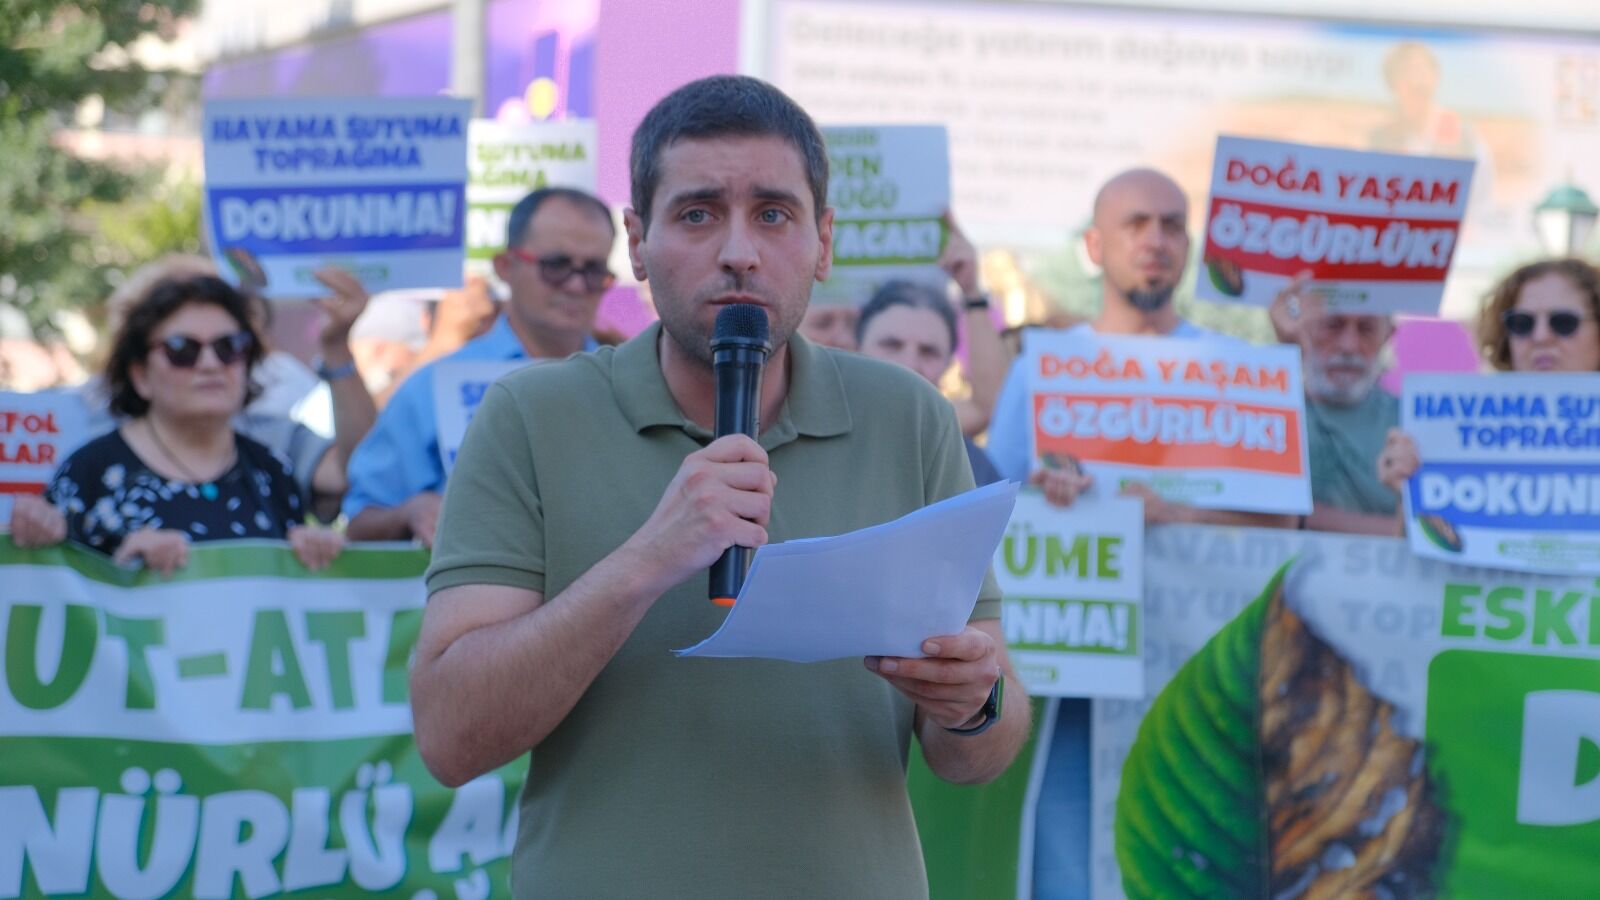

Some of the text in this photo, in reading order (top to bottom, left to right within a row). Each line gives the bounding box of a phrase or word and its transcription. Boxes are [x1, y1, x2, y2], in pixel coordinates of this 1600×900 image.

[212, 116, 461, 139] HAVAMA SUYUMA
[1226, 156, 1459, 213] DOĞA YAŞAM
[220, 191, 457, 242] DOKUNMA!
[1208, 203, 1458, 268] ÖZGÜRLÜK!
[1039, 350, 1289, 396] DOĞA YAŞAM
[1038, 396, 1287, 454] ÖZGÜRLÜK!
[1413, 394, 1548, 418] HAVAMA
[1420, 472, 1600, 516] DOKUN
[1002, 524, 1122, 578] ÜME
[1004, 602, 1130, 650] NMA!
